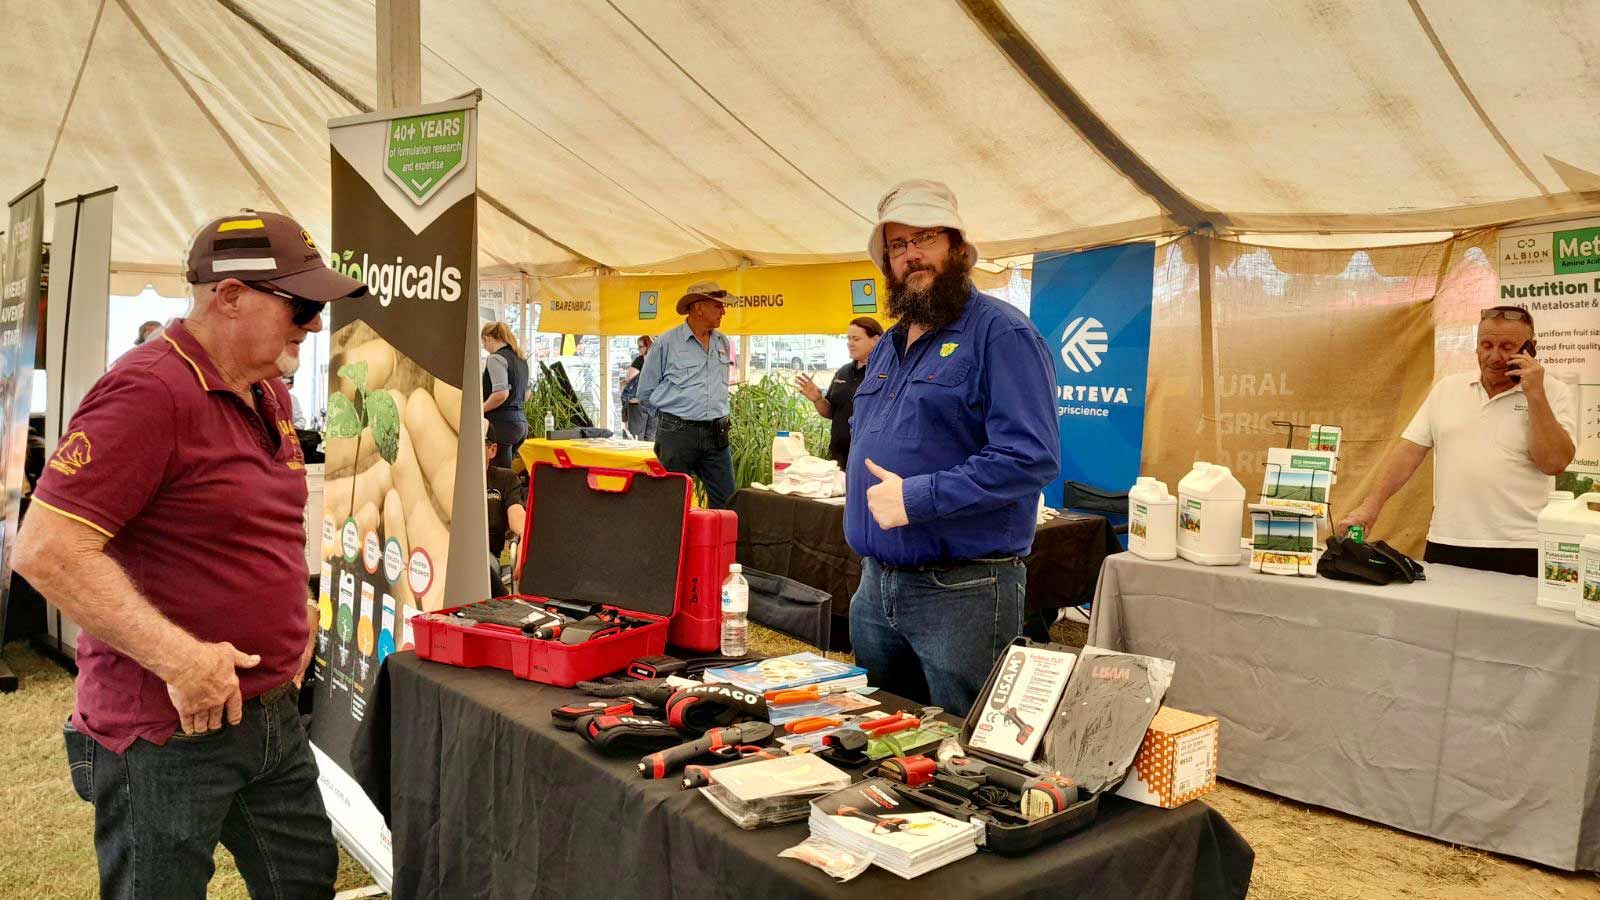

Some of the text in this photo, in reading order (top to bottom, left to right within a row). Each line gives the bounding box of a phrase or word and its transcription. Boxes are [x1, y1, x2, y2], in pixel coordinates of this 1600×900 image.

[393, 117, 461, 141] 40+ YEARS
[432, 141, 462, 154] research
[402, 160, 444, 172] and expertise
[1505, 250, 1549, 261] ALBION
[1501, 281, 1588, 299] Nutrition
[555, 300, 591, 312] BARENBRUG
[1531, 299, 1590, 311] Metalosate
[1538, 329, 1572, 338] uniform
[1573, 328, 1588, 337] fruit
[1535, 343, 1557, 351] oved
[1558, 342, 1576, 351] fruit
[1543, 356, 1586, 365] absorption
[1057, 404, 1109, 417] griscience
[1570, 457, 1599, 468] helated
[992, 656, 1023, 703] LISAM
[684, 686, 758, 705] INFACO
